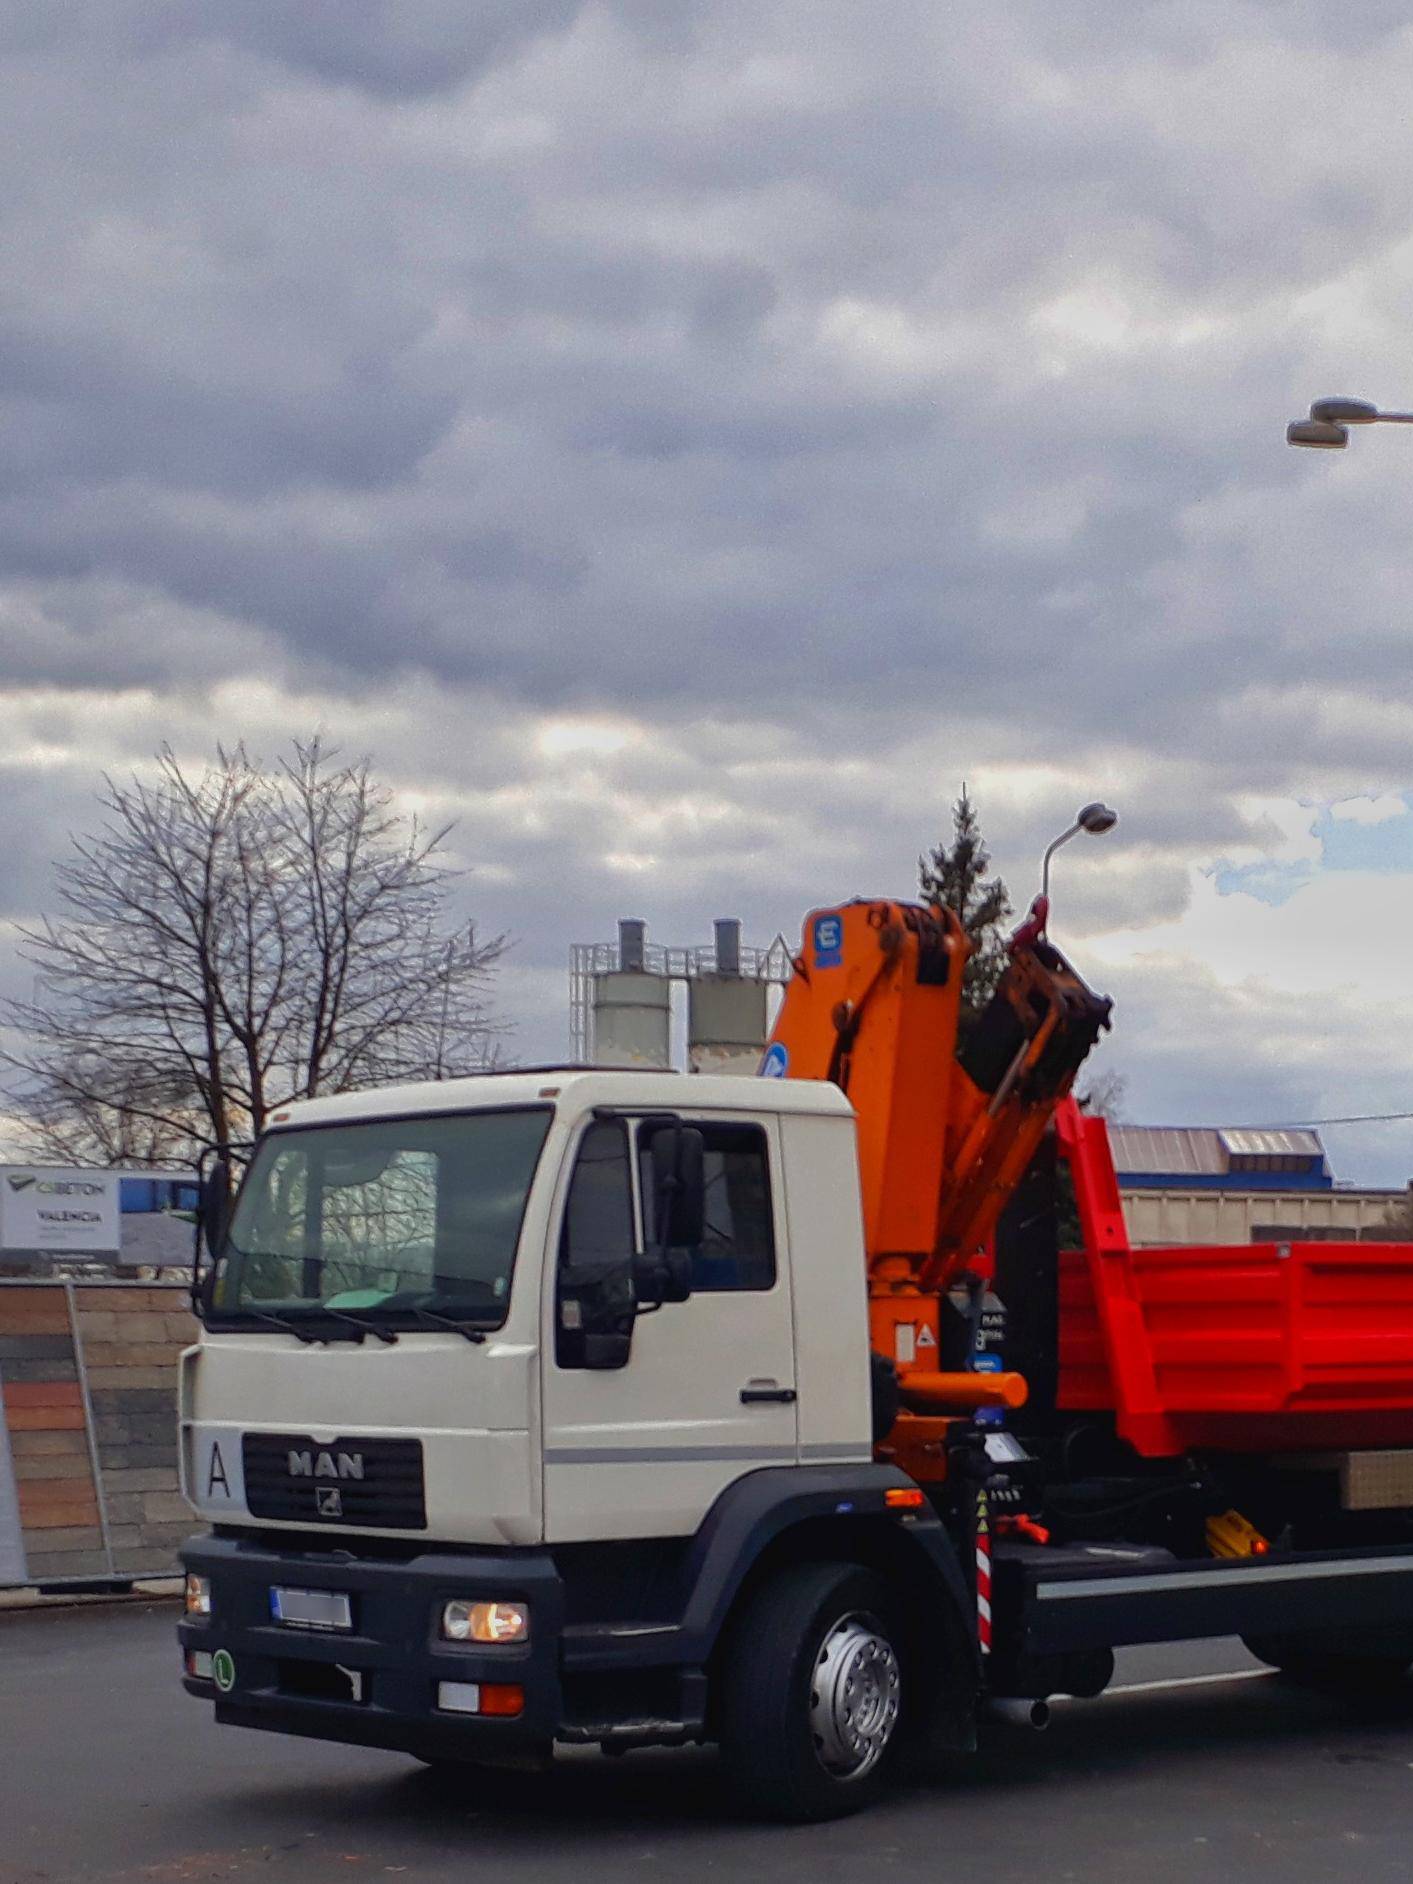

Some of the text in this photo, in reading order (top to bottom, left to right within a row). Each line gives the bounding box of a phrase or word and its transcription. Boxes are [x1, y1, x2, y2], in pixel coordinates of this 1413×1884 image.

[37, 1209, 102, 1222] VALENCIA
[208, 1441, 231, 1499] A
[288, 1450, 364, 1480] MAN
